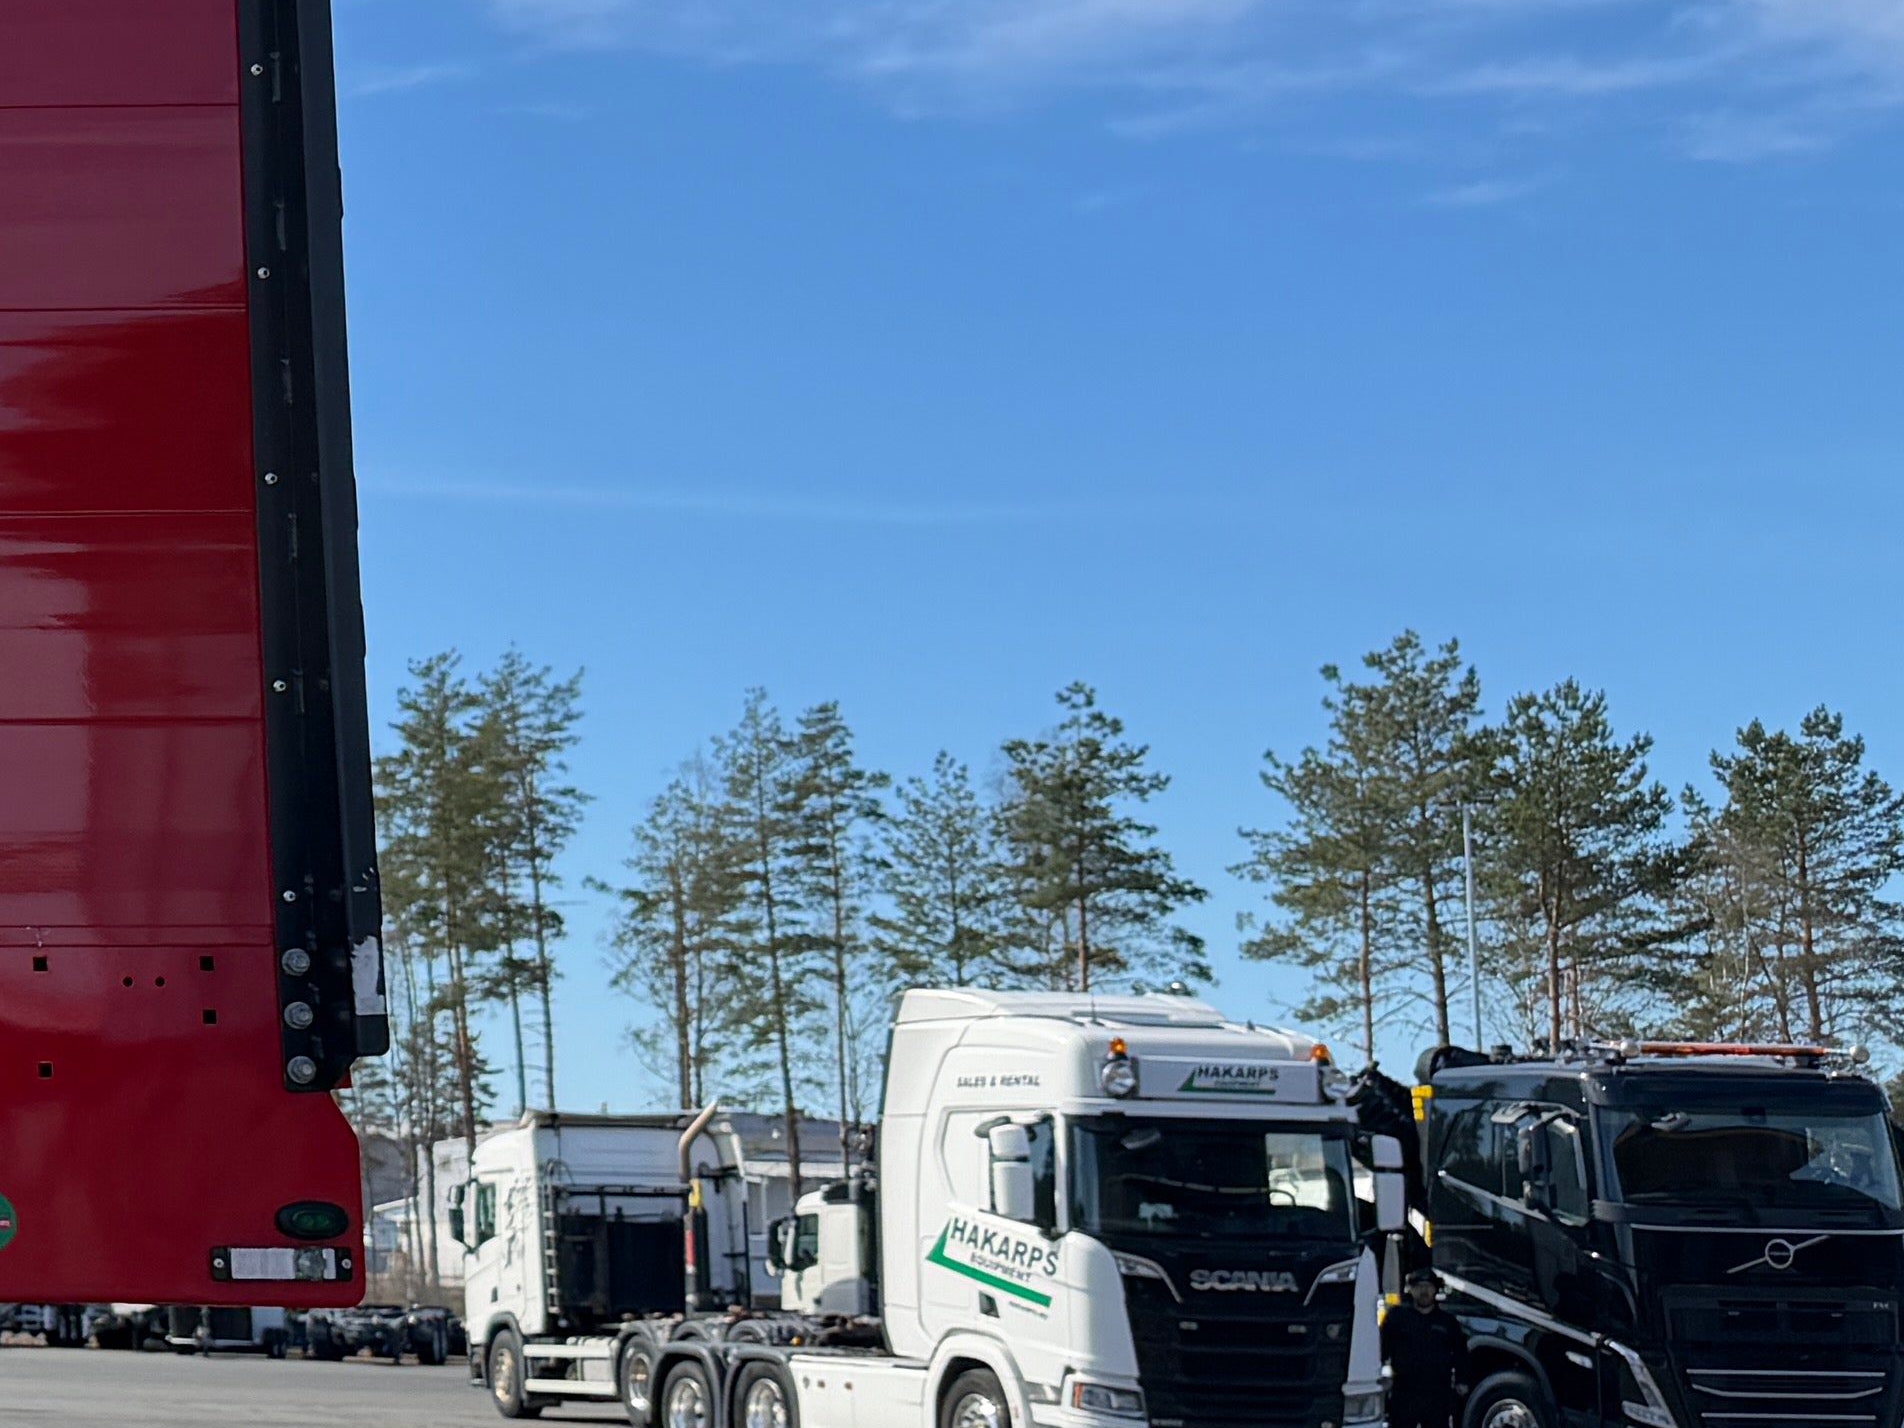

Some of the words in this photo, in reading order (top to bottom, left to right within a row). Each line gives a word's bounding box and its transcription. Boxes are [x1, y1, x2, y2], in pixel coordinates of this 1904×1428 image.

[1197, 1065, 1279, 1081] HAKARPS
[950, 1217, 1059, 1276] HAKARPS
[1190, 1269, 1299, 1292] SCANIA
